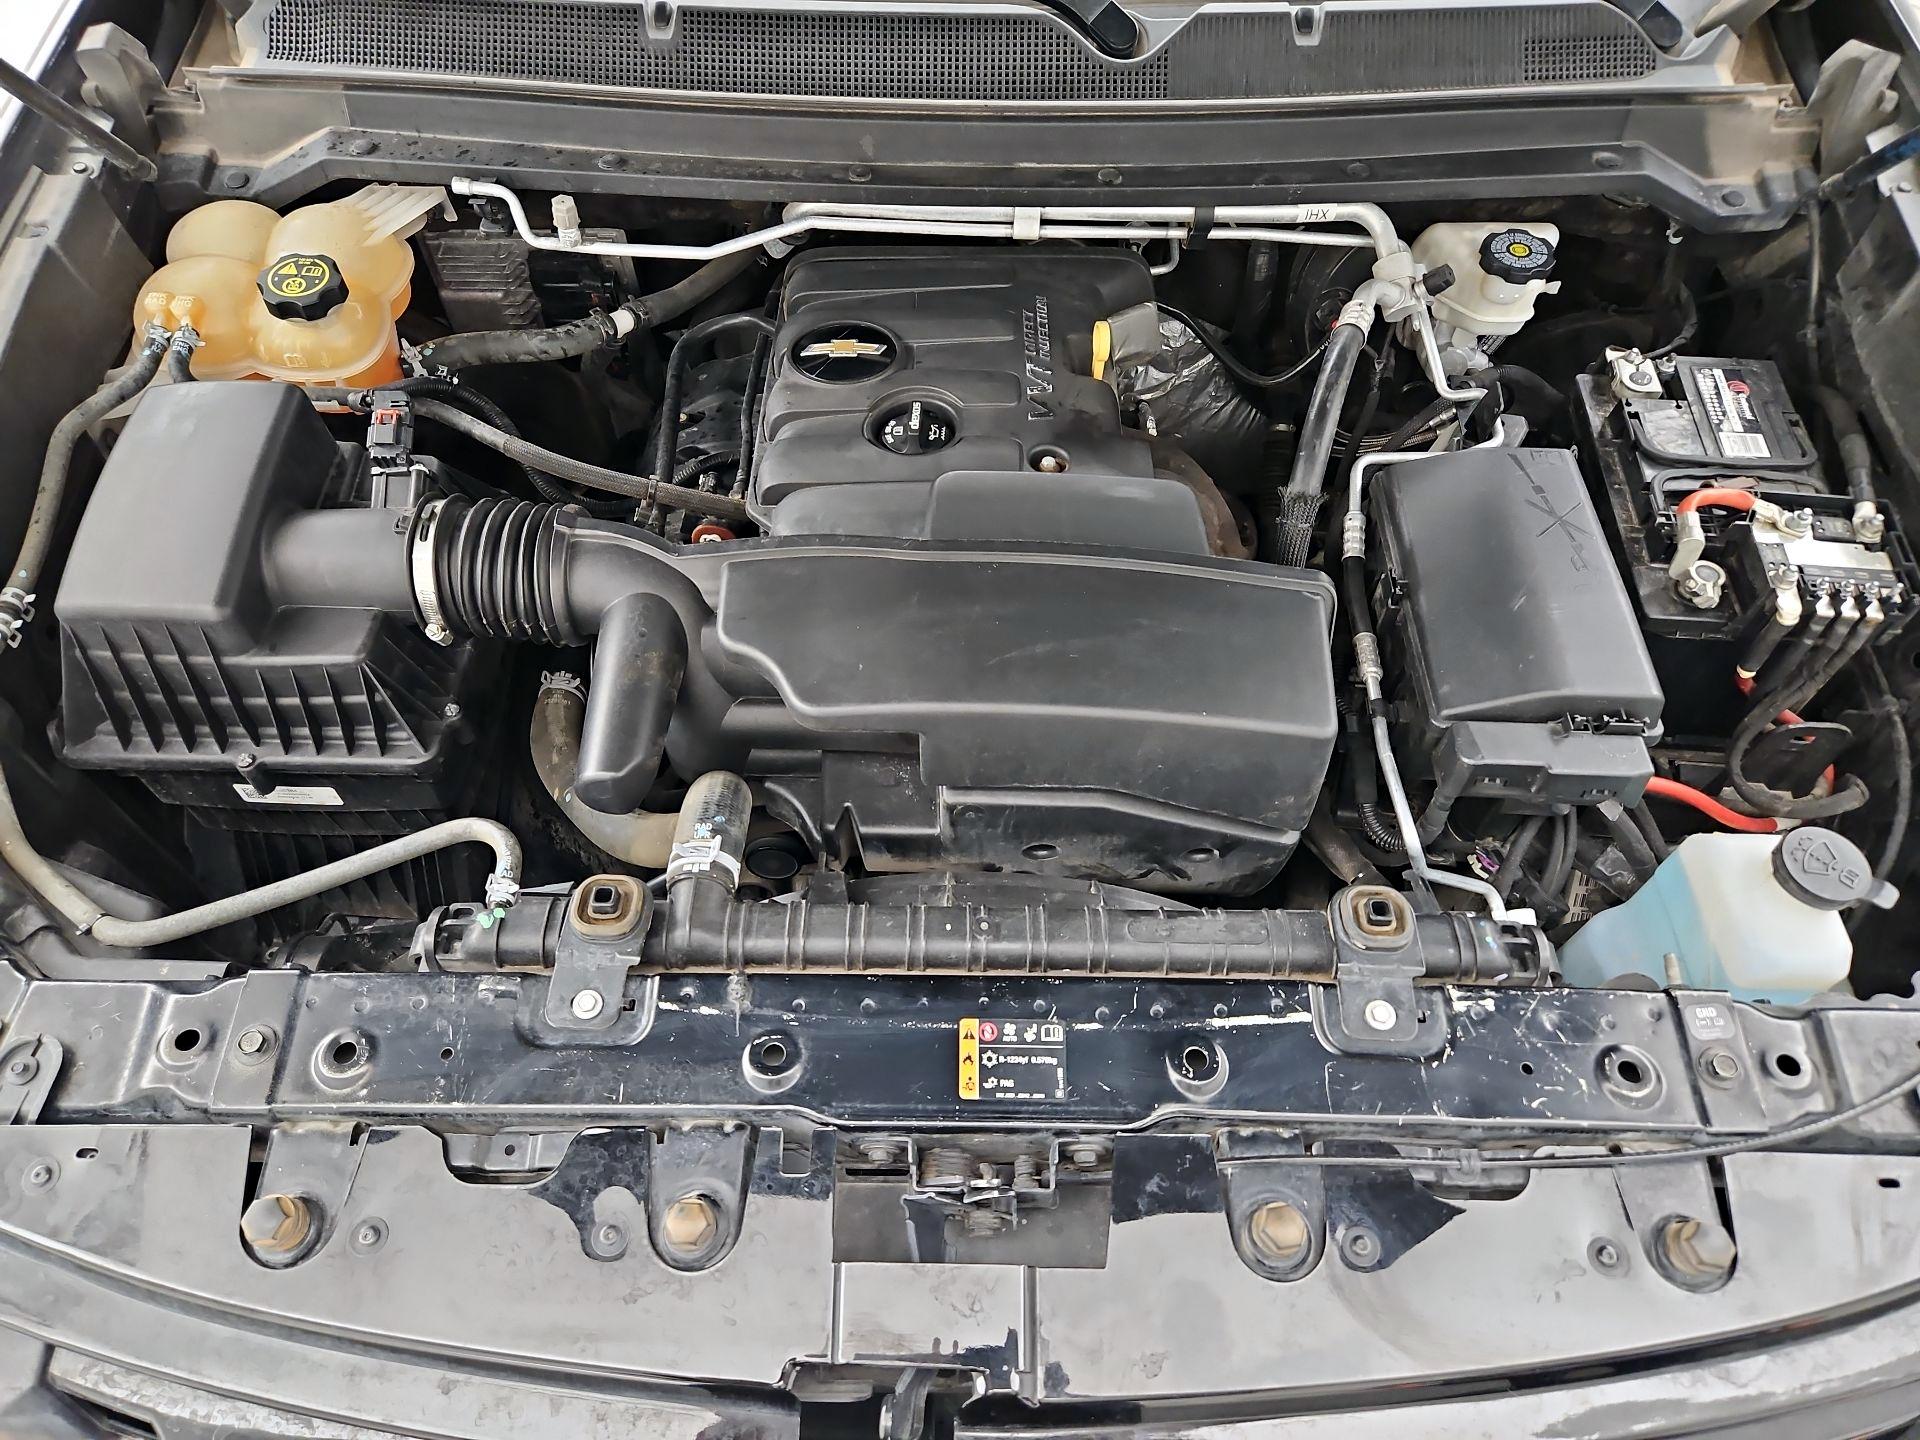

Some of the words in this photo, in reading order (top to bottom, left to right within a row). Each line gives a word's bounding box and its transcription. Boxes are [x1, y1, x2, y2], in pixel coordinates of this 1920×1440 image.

[1026, 359, 1054, 421] VVT
[908, 401, 922, 430] dexos
[694, 822, 713, 831] RAD
[1695, 1006, 1717, 1018] GND
